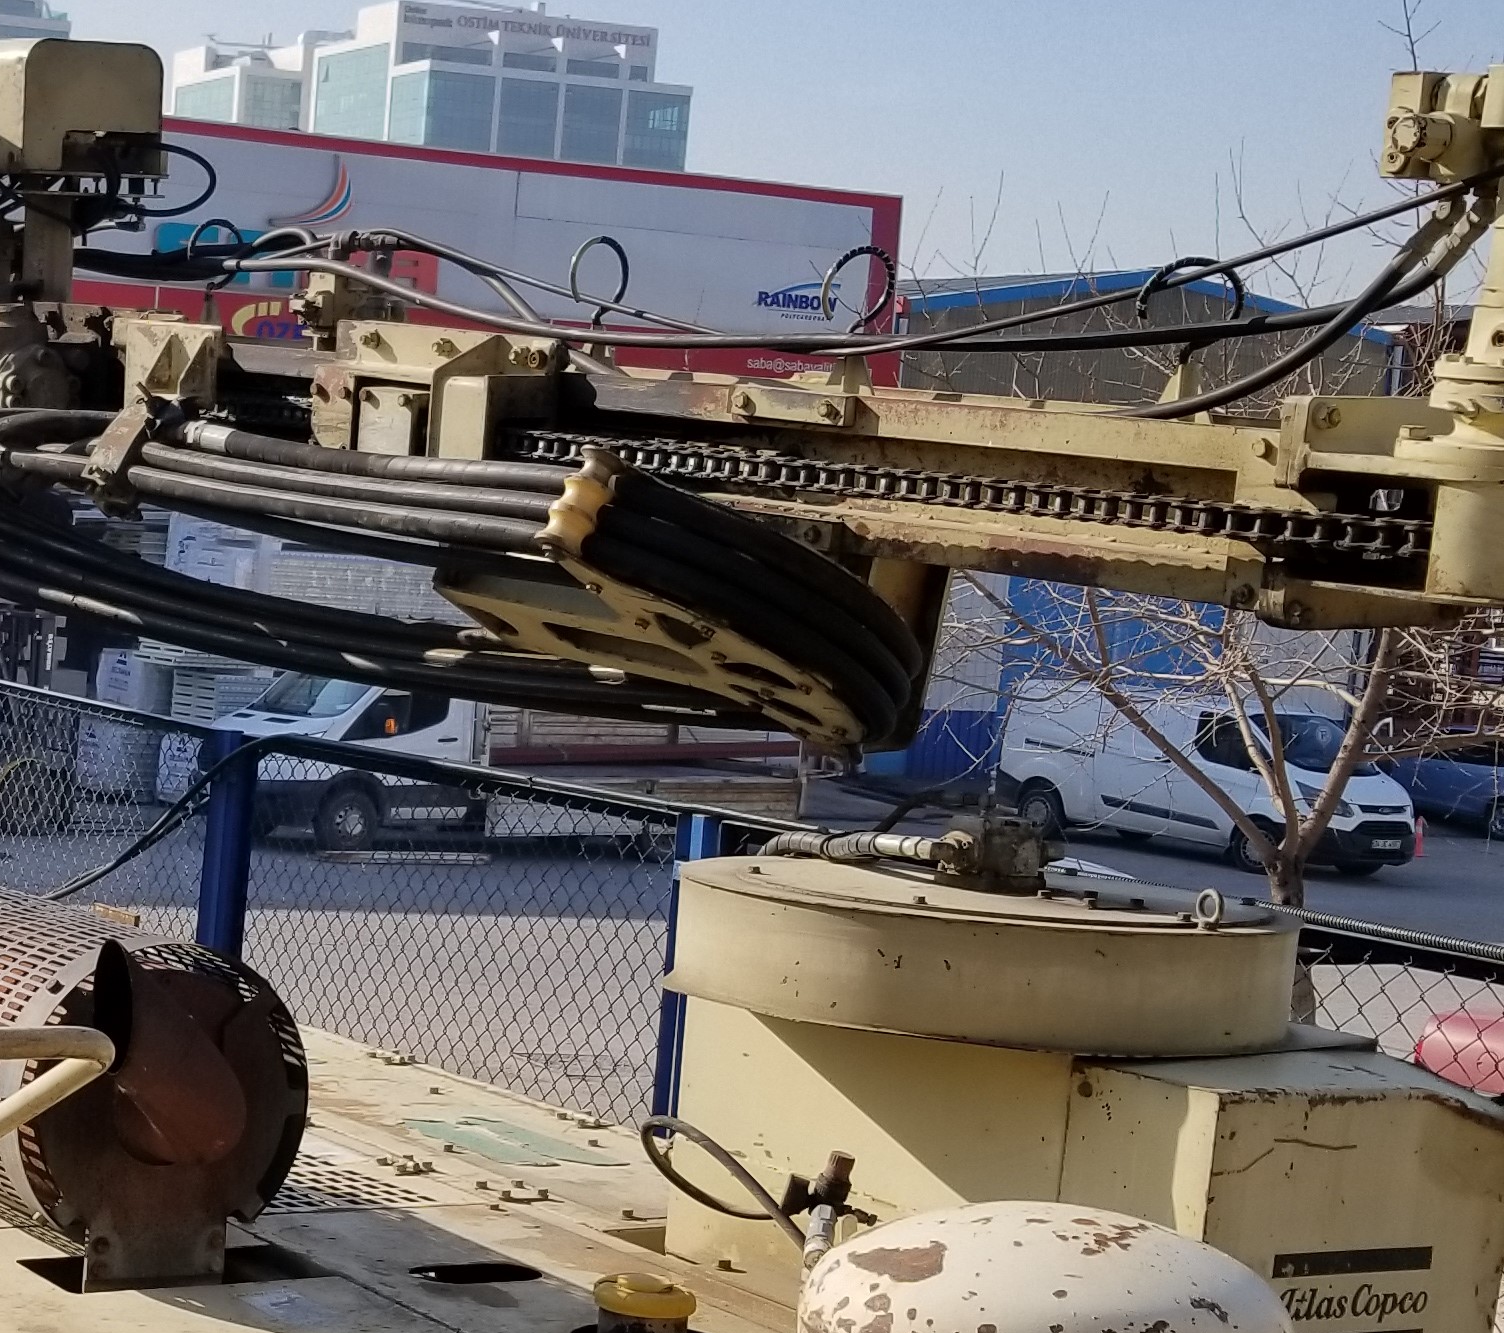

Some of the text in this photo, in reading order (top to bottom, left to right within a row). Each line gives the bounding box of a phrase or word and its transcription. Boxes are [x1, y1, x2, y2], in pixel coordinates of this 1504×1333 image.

[457, 14, 499, 31] OSTİM
[501, 20, 553, 37] TEKNİK
[555, 23, 651, 47] ÜNİVERSİTESİ
[780, 313, 826, 322] POLYCARBONA
[1280, 1283, 1428, 1323] Atlas Copco
